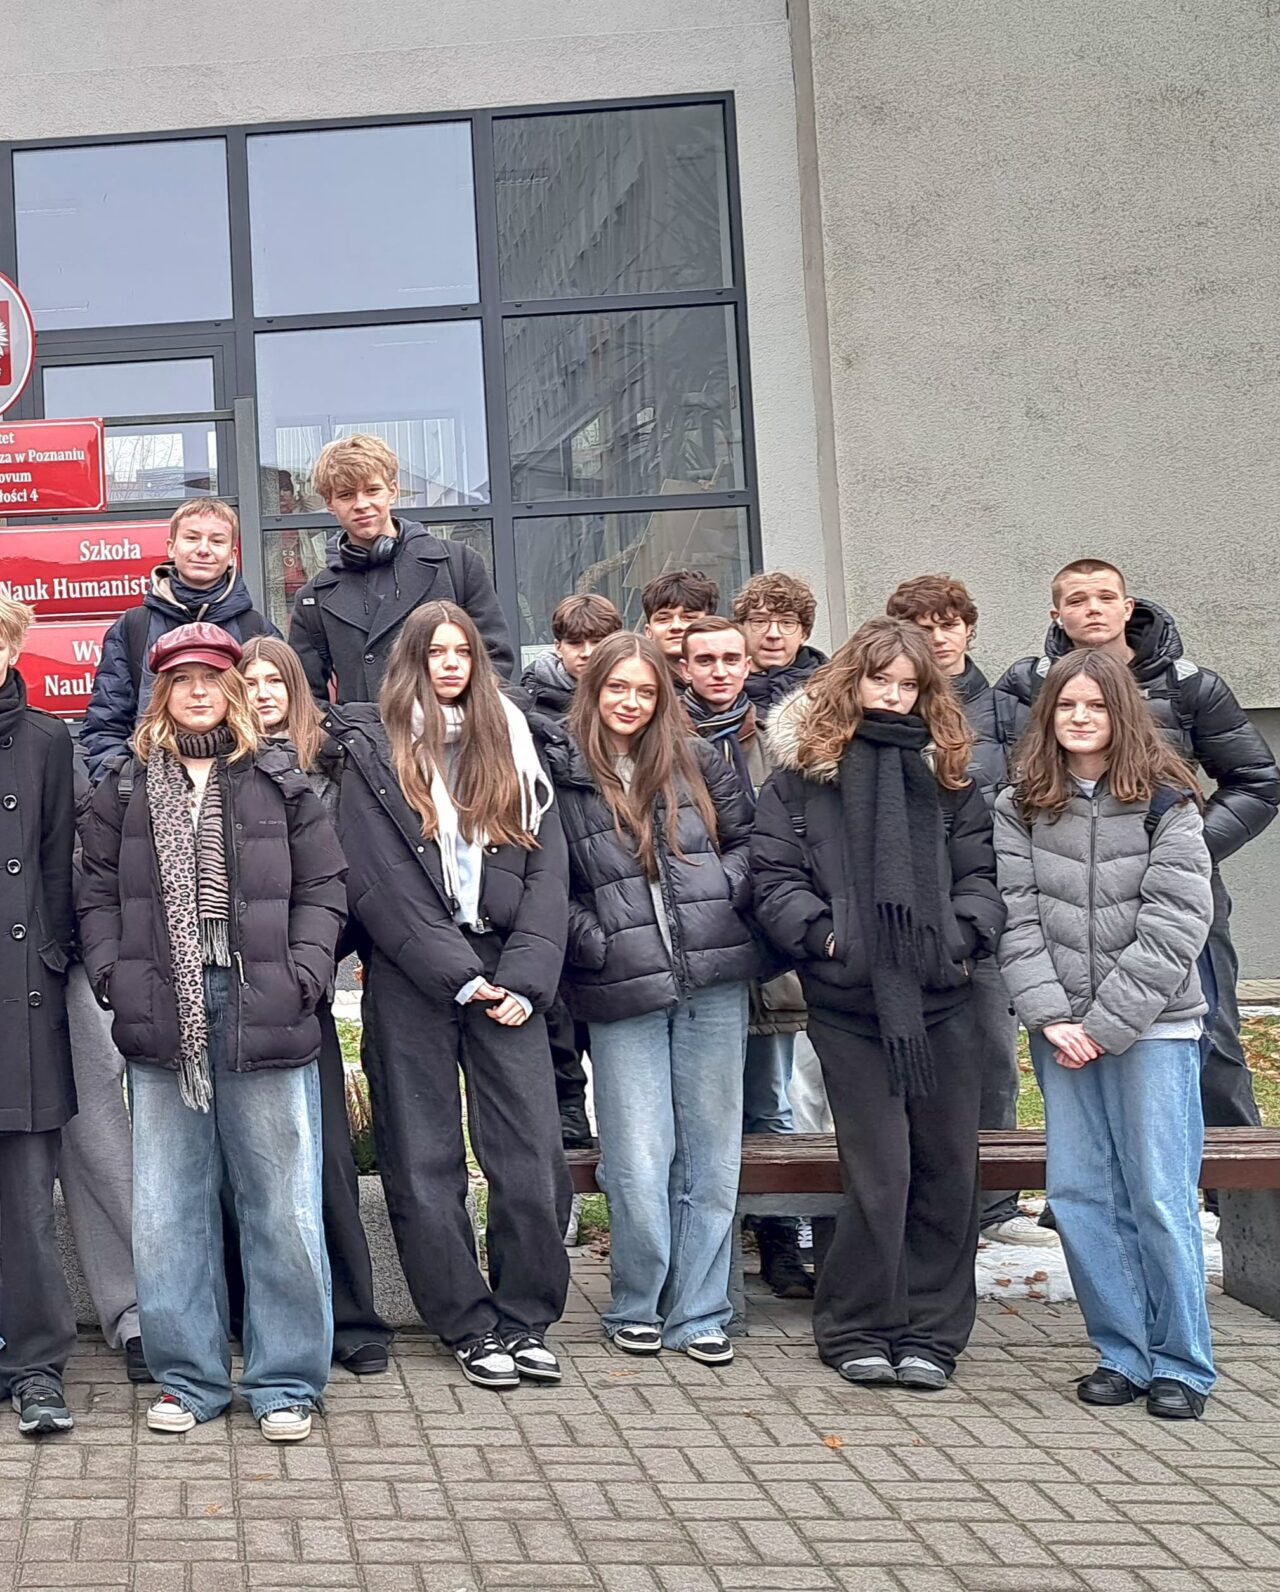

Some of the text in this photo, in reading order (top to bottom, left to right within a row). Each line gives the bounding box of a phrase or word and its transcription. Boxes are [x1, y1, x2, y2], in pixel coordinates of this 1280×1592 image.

[14, 453, 27, 463] w
[28, 448, 85, 463] Poznaniu
[29, 488, 39, 502] 4
[79, 538, 142, 561] Szkoła
[53, 574, 150, 600] Humanist
